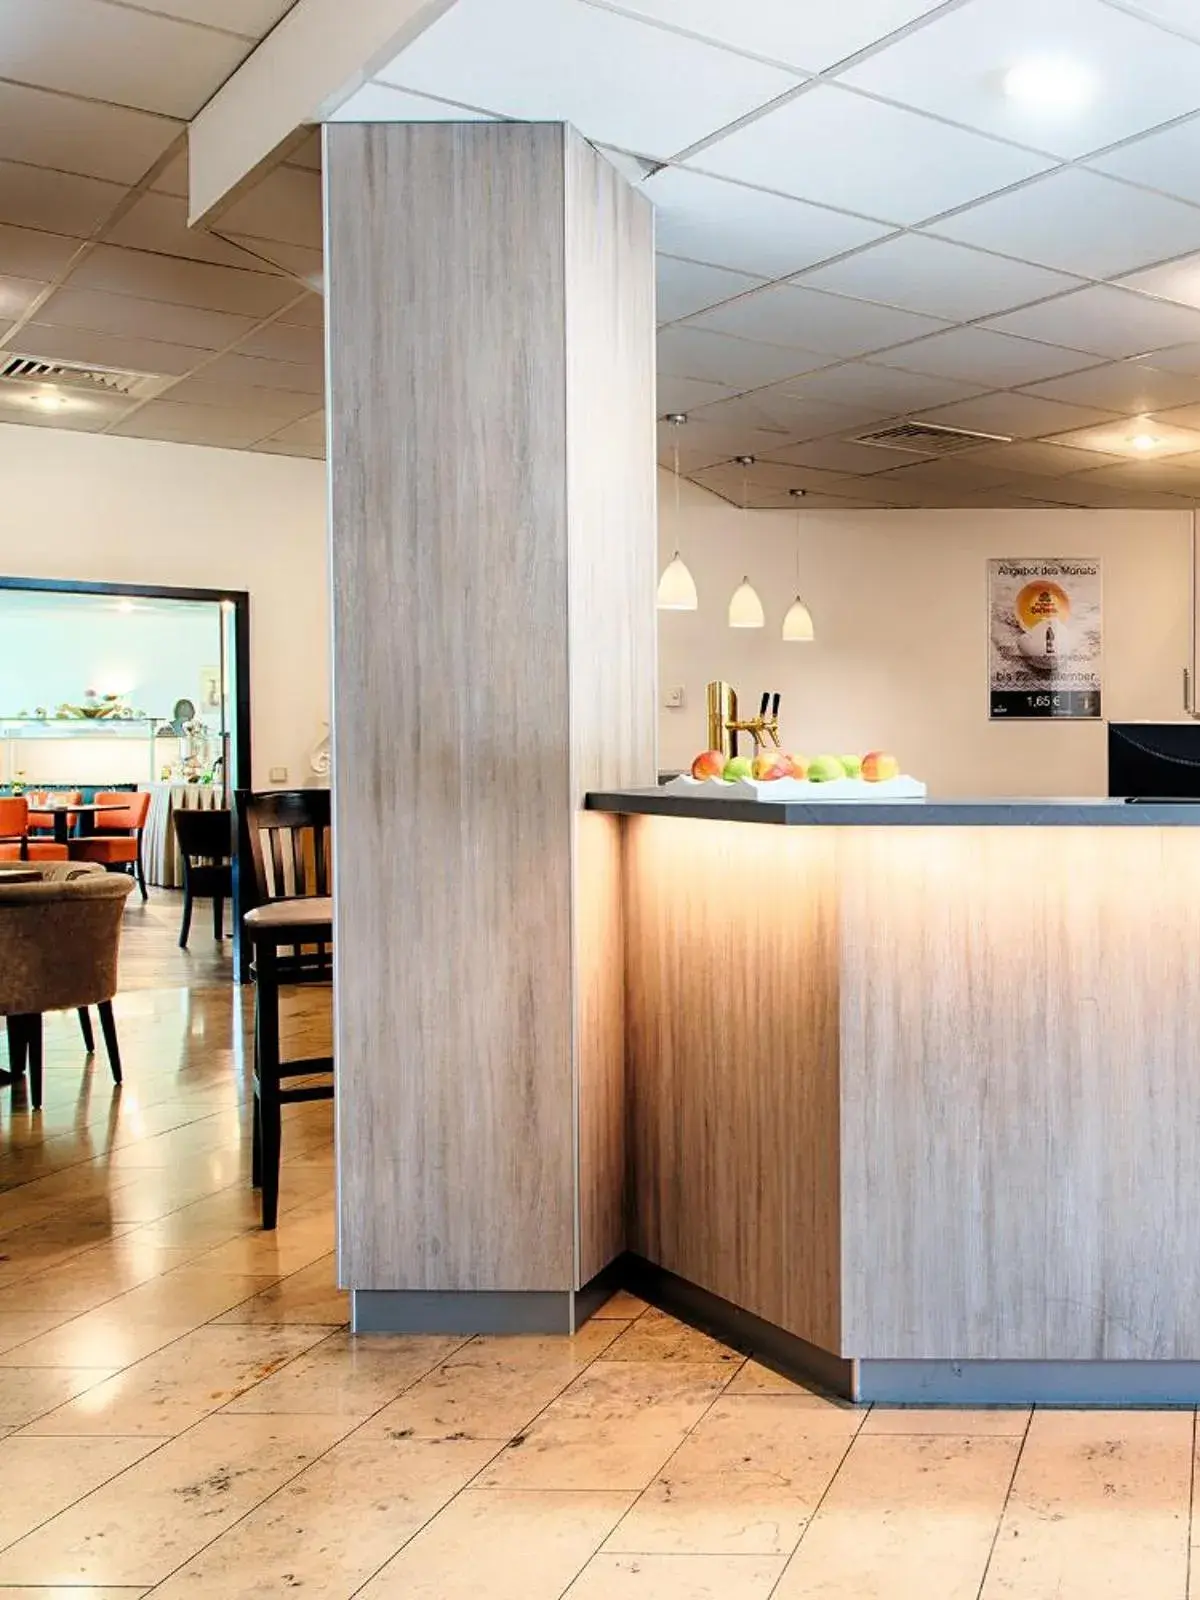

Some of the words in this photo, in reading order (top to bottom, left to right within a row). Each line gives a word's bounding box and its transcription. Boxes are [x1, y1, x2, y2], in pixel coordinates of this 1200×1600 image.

[998, 566, 1038, 577] Angebot
[1041, 566, 1058, 575] des
[1060, 566, 1097, 575] Monats
[996, 671, 1012, 681] bis
[1034, 671, 1096, 682] Stember
[1026, 695, 1050, 707] 1,65
[1052, 695, 1061, 706] €
